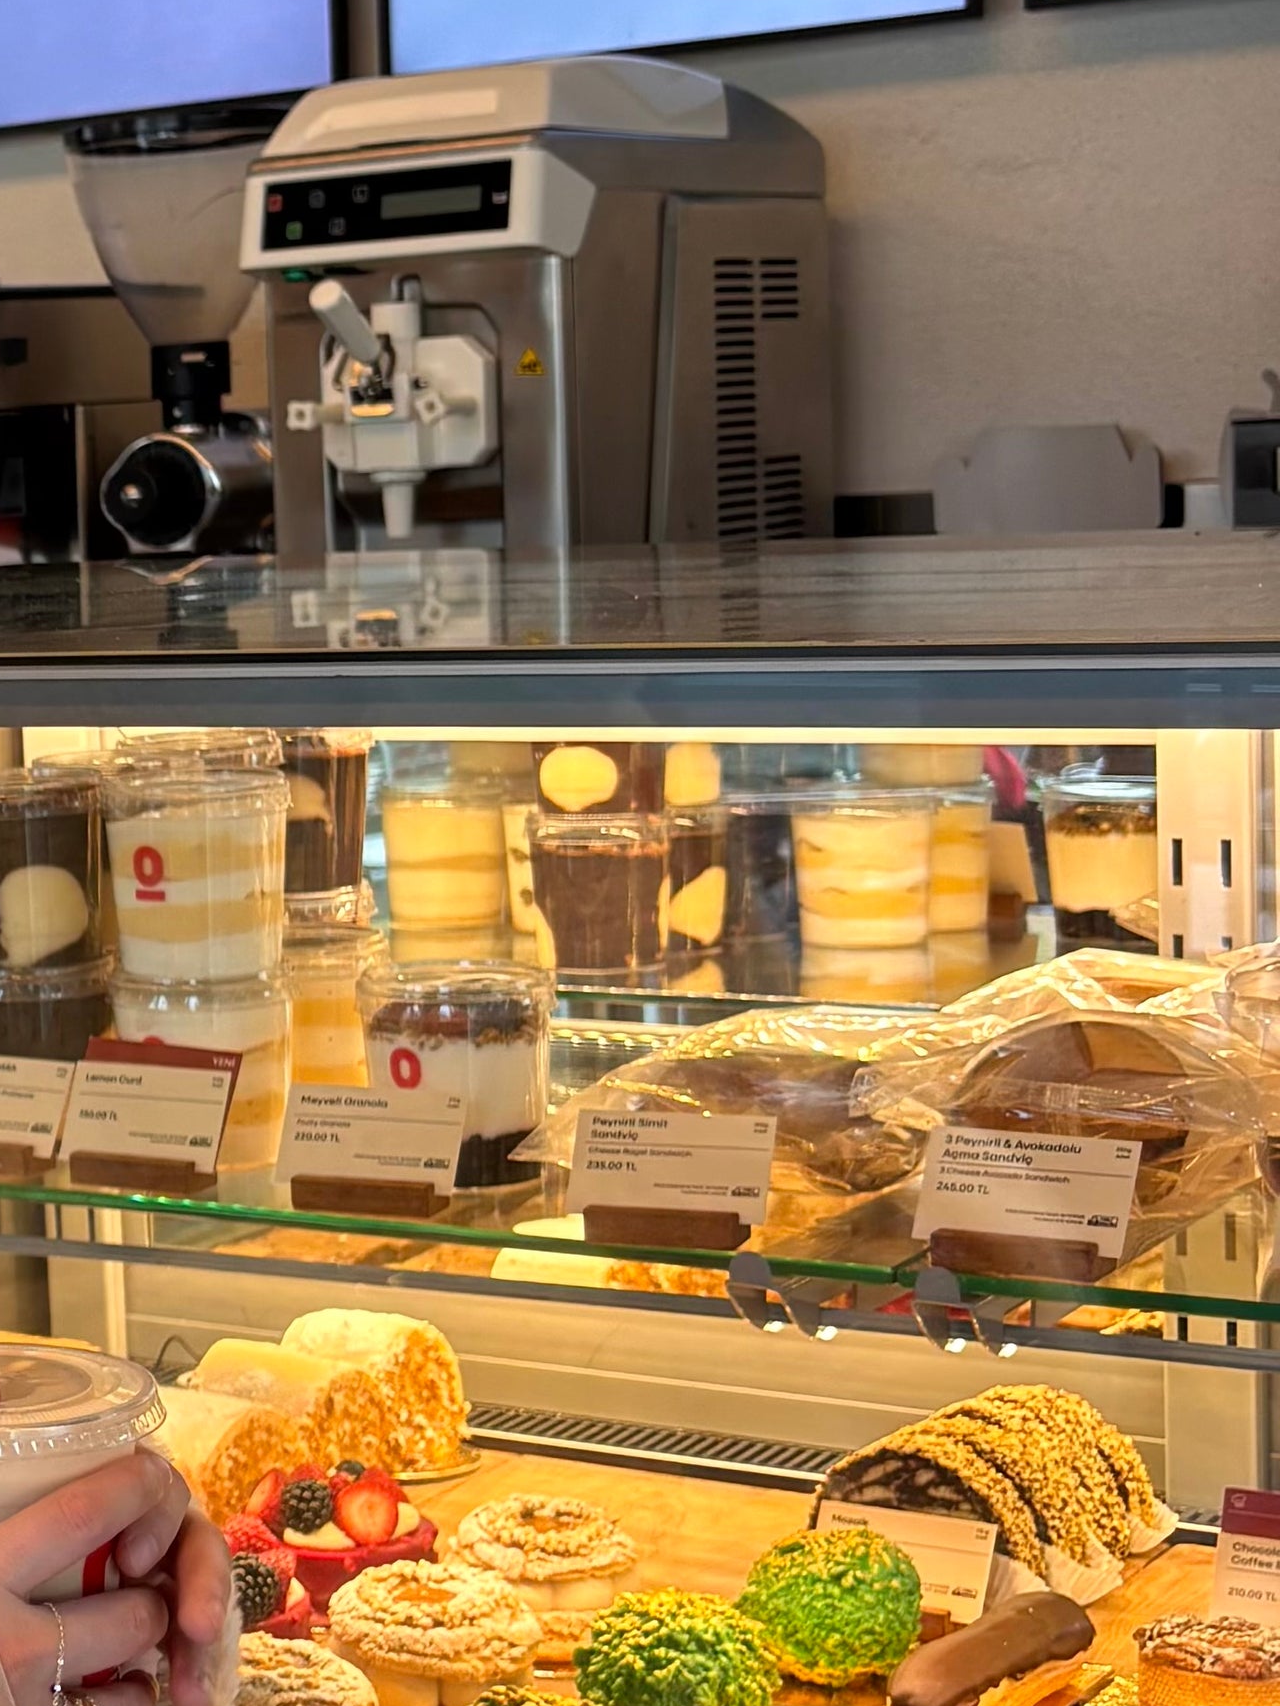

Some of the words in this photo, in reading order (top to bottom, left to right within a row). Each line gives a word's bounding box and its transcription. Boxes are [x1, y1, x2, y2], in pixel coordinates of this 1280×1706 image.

[213, 1056, 236, 1068] YENİ
[86, 1073, 117, 1083] Lemon
[119, 1074, 142, 1085] Curd
[344, 1097, 388, 1108] Granola
[592, 1115, 636, 1129] Peynirli
[638, 1117, 668, 1129] Simit
[329, 1131, 340, 1143] TL
[591, 1129, 638, 1141] Sandviç
[945, 1134, 953, 1144] 3
[955, 1135, 1001, 1150] Peynirli
[1003, 1138, 1011, 1149] &
[1014, 1139, 1082, 1154] Avokadolu
[942, 1148, 980, 1162] Açma
[982, 1151, 1033, 1166] Sandviç
[625, 1160, 637, 1172] TL
[946, 1167, 980, 1177] Cheese
[1025, 1173, 1070, 1184] Sandwich
[936, 1181, 974, 1193] 245.00
[978, 1183, 990, 1195] TL
[1231, 1554, 1272, 1569] Coffee
[1228, 1586, 1262, 1601] 210.00
[1265, 1591, 1278, 1602] TL
